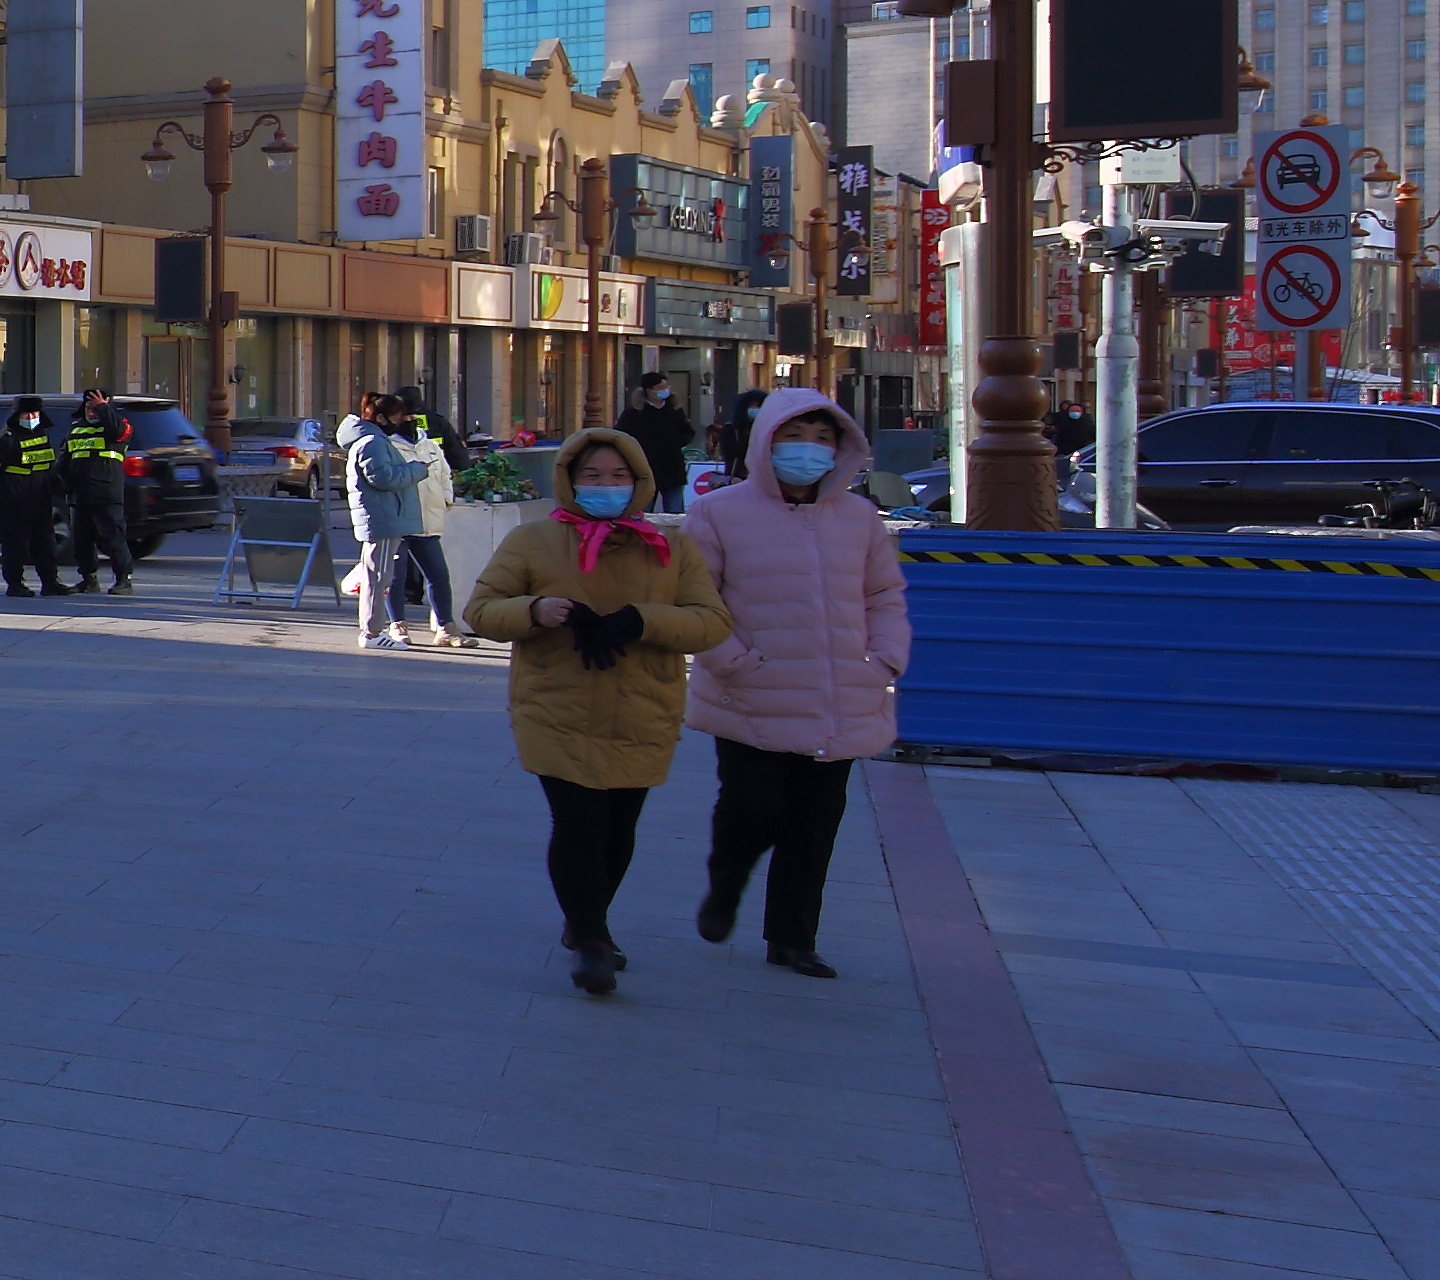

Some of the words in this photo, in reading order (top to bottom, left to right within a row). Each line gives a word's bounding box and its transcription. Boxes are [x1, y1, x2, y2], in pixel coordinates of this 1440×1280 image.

[1264, 219, 1341, 238] 观光车除外
